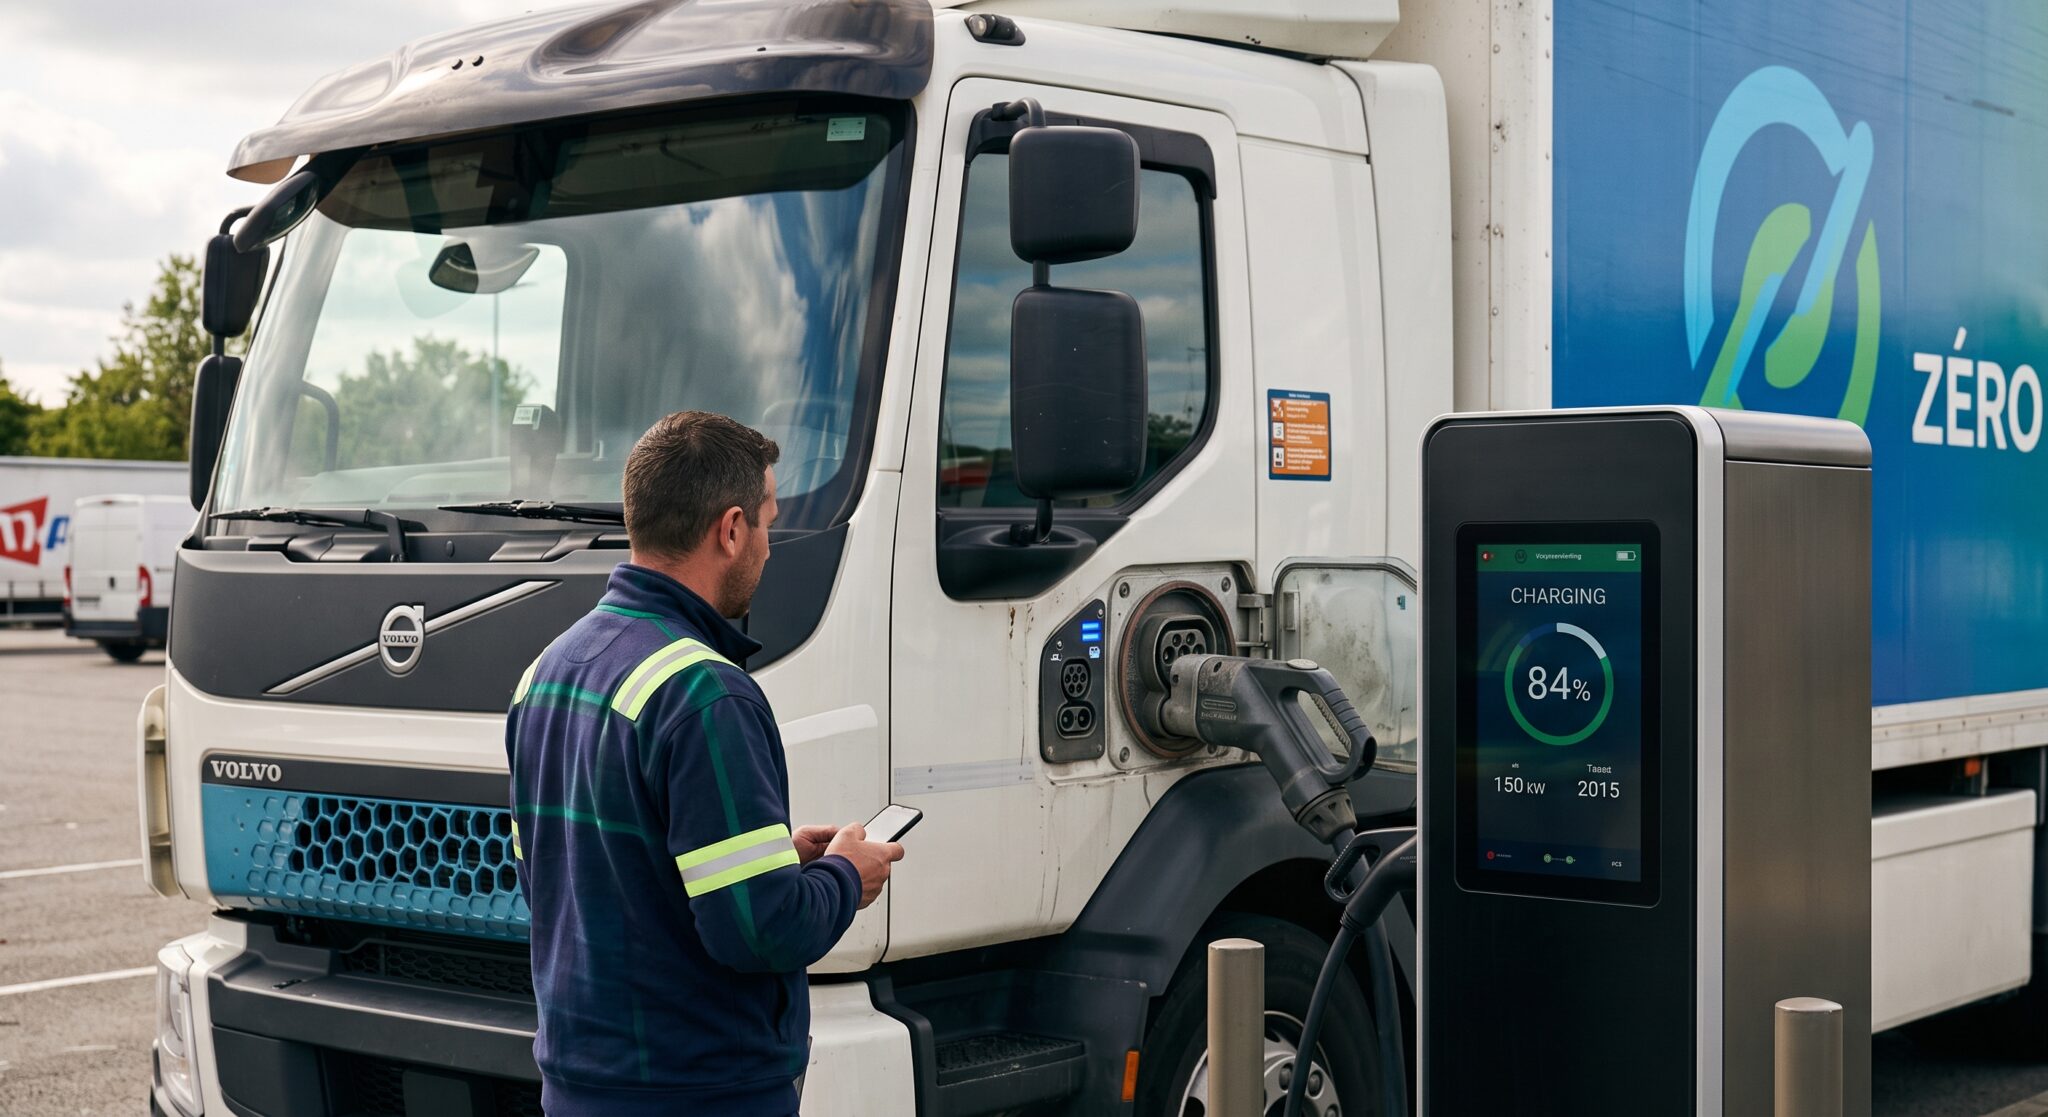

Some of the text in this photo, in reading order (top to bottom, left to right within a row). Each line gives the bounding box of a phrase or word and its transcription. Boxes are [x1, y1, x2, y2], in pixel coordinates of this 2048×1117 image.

[1912, 326, 2044, 453] ZÉRO
[1510, 587, 1606, 605] CHARGING
[383, 634, 419, 644] VOLVO
[1527, 666, 1591, 702] 84%
[210, 760, 282, 783] VOLVO
[1494, 776, 1546, 795] 150 kW
[1577, 780, 1620, 799] 2015
